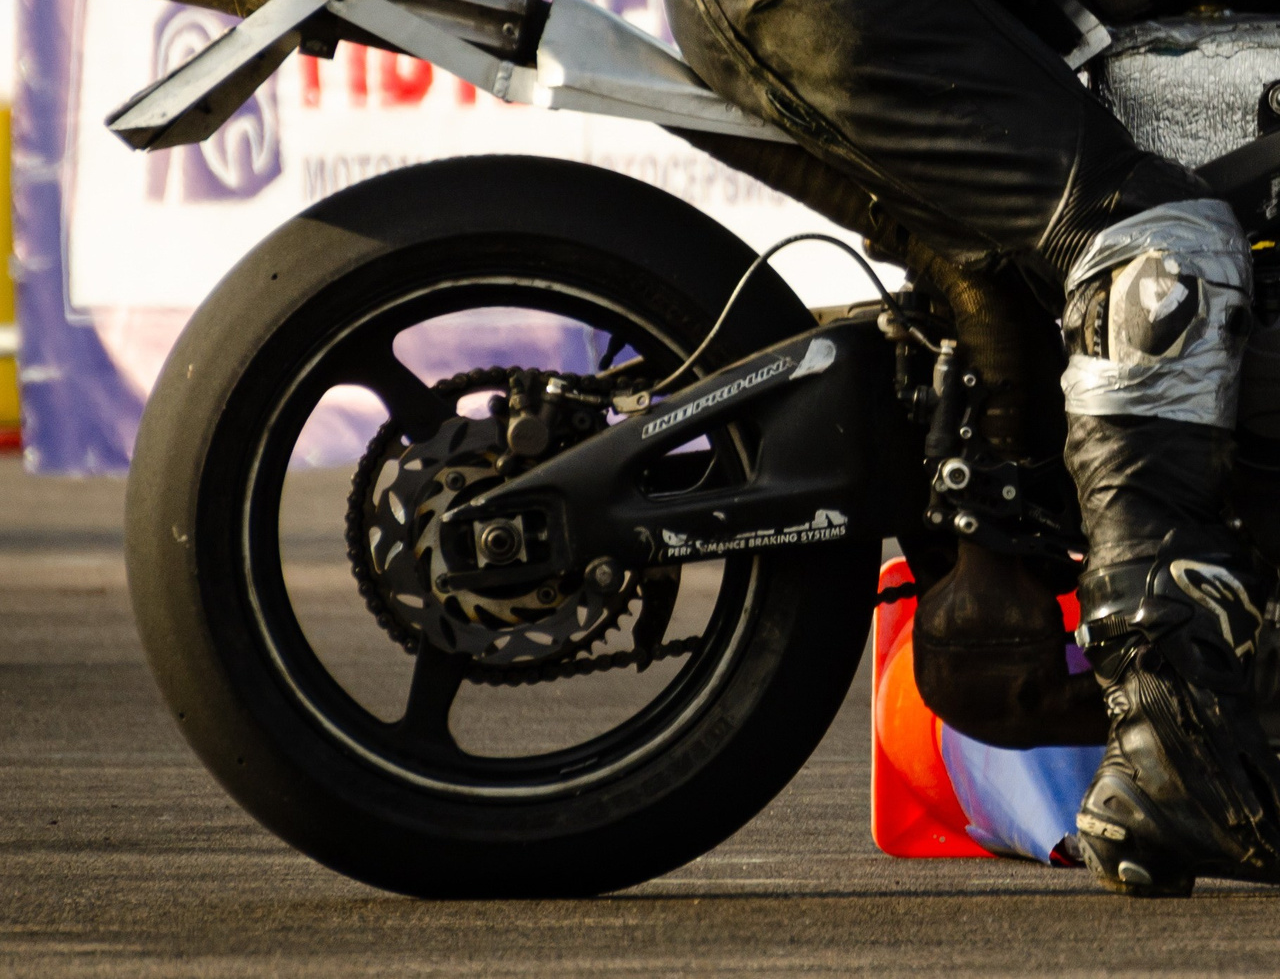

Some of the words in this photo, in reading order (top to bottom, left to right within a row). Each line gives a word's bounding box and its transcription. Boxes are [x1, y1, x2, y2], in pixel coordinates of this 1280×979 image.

[642, 402, 693, 439] UNIT
[748, 534, 798, 548] BRAKING
[801, 525, 846, 542] SYSTEMS
